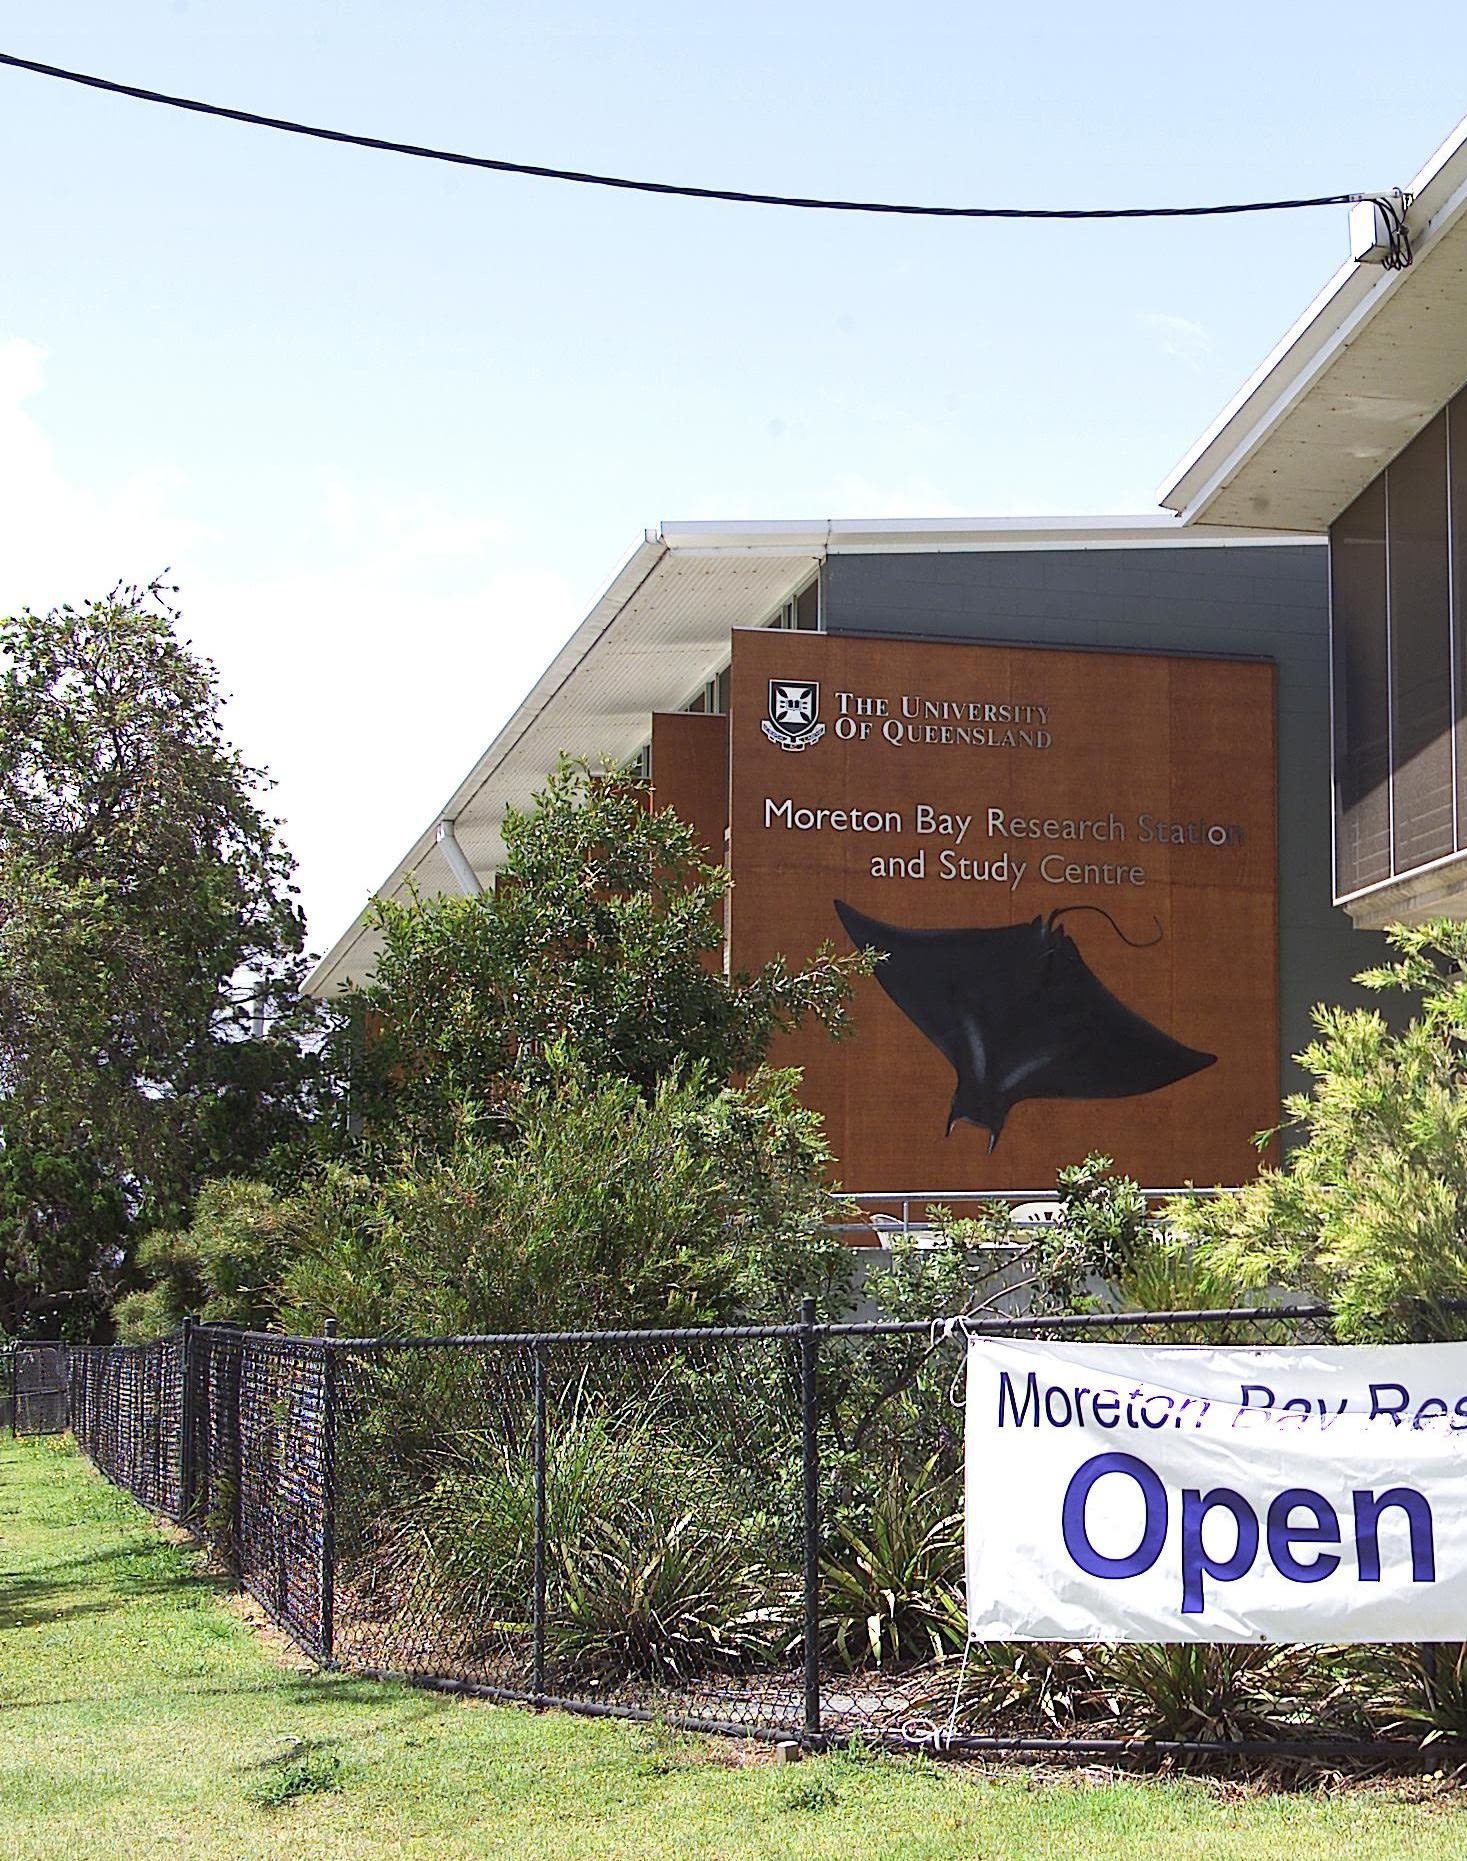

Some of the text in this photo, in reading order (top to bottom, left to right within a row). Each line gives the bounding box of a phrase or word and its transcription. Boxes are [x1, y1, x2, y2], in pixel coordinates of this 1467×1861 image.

[764, 798, 1246, 846] Moreton Bay Research Station
[870, 850, 1146, 891] and Study Centre
[998, 1371, 1211, 1429] Moreton
[1061, 1451, 1437, 1614] Open
